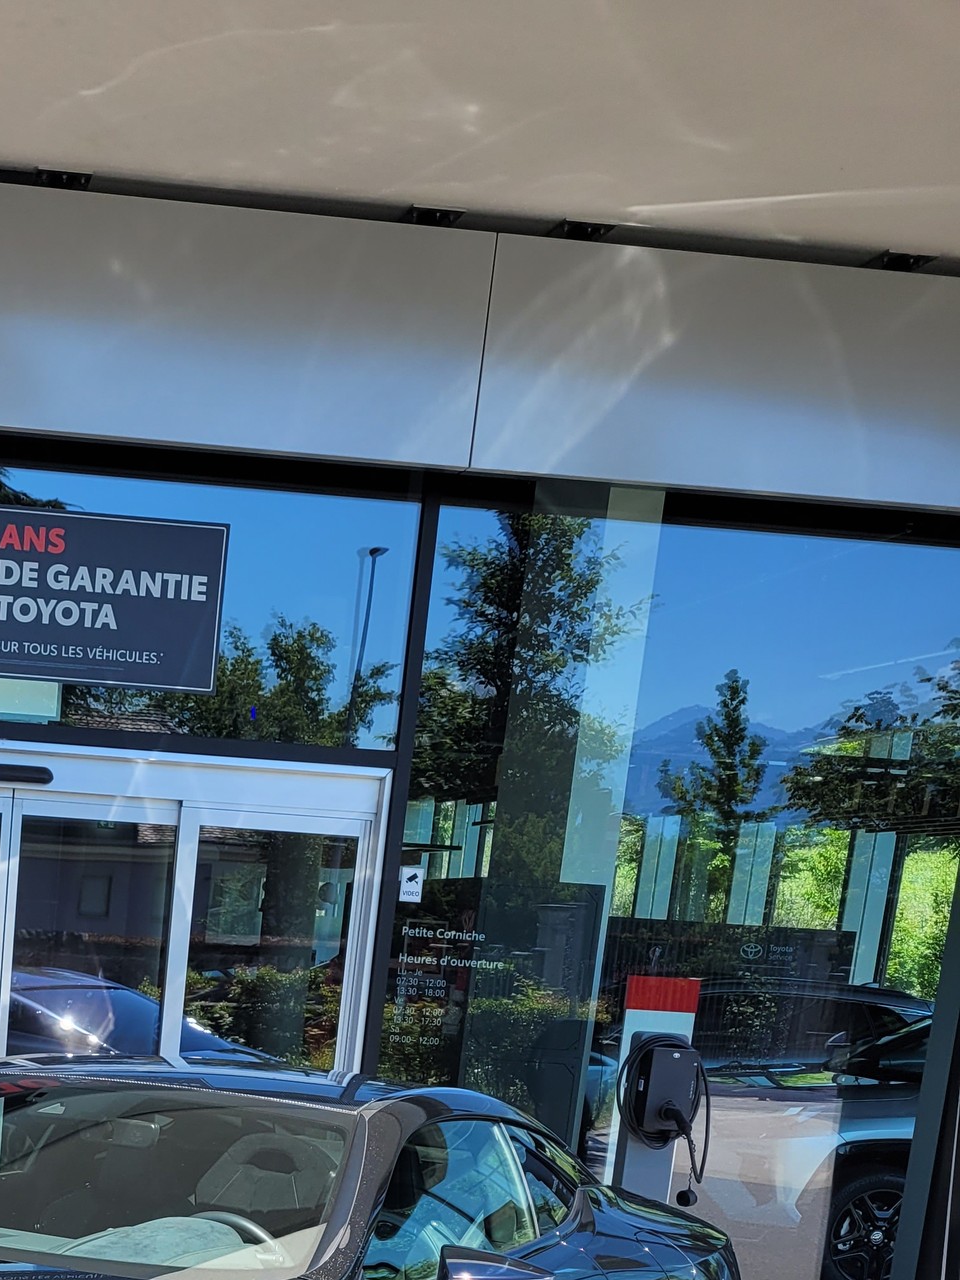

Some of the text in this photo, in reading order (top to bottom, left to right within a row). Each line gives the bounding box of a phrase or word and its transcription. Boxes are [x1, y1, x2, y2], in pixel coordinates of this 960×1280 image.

[46, 564, 209, 602] GARANTIE
[22, 641, 58, 657] TOUS
[61, 644, 84, 658] LES
[401, 926, 486, 942] Petite Corniche
[769, 944, 794, 954] Toyota
[398, 953, 438, 966] Heures
[396, 976, 418, 986] 07:30
[426, 978, 447, 988] 12:00
[396, 986, 417, 996] 13:30
[425, 988, 446, 998] 18:00
[393, 1006, 415, 1015] 07:30
[421, 1017, 442, 1026] 17:30
[390, 1025, 400, 1034] Sa
[389, 1034, 411, 1044] 09:00
